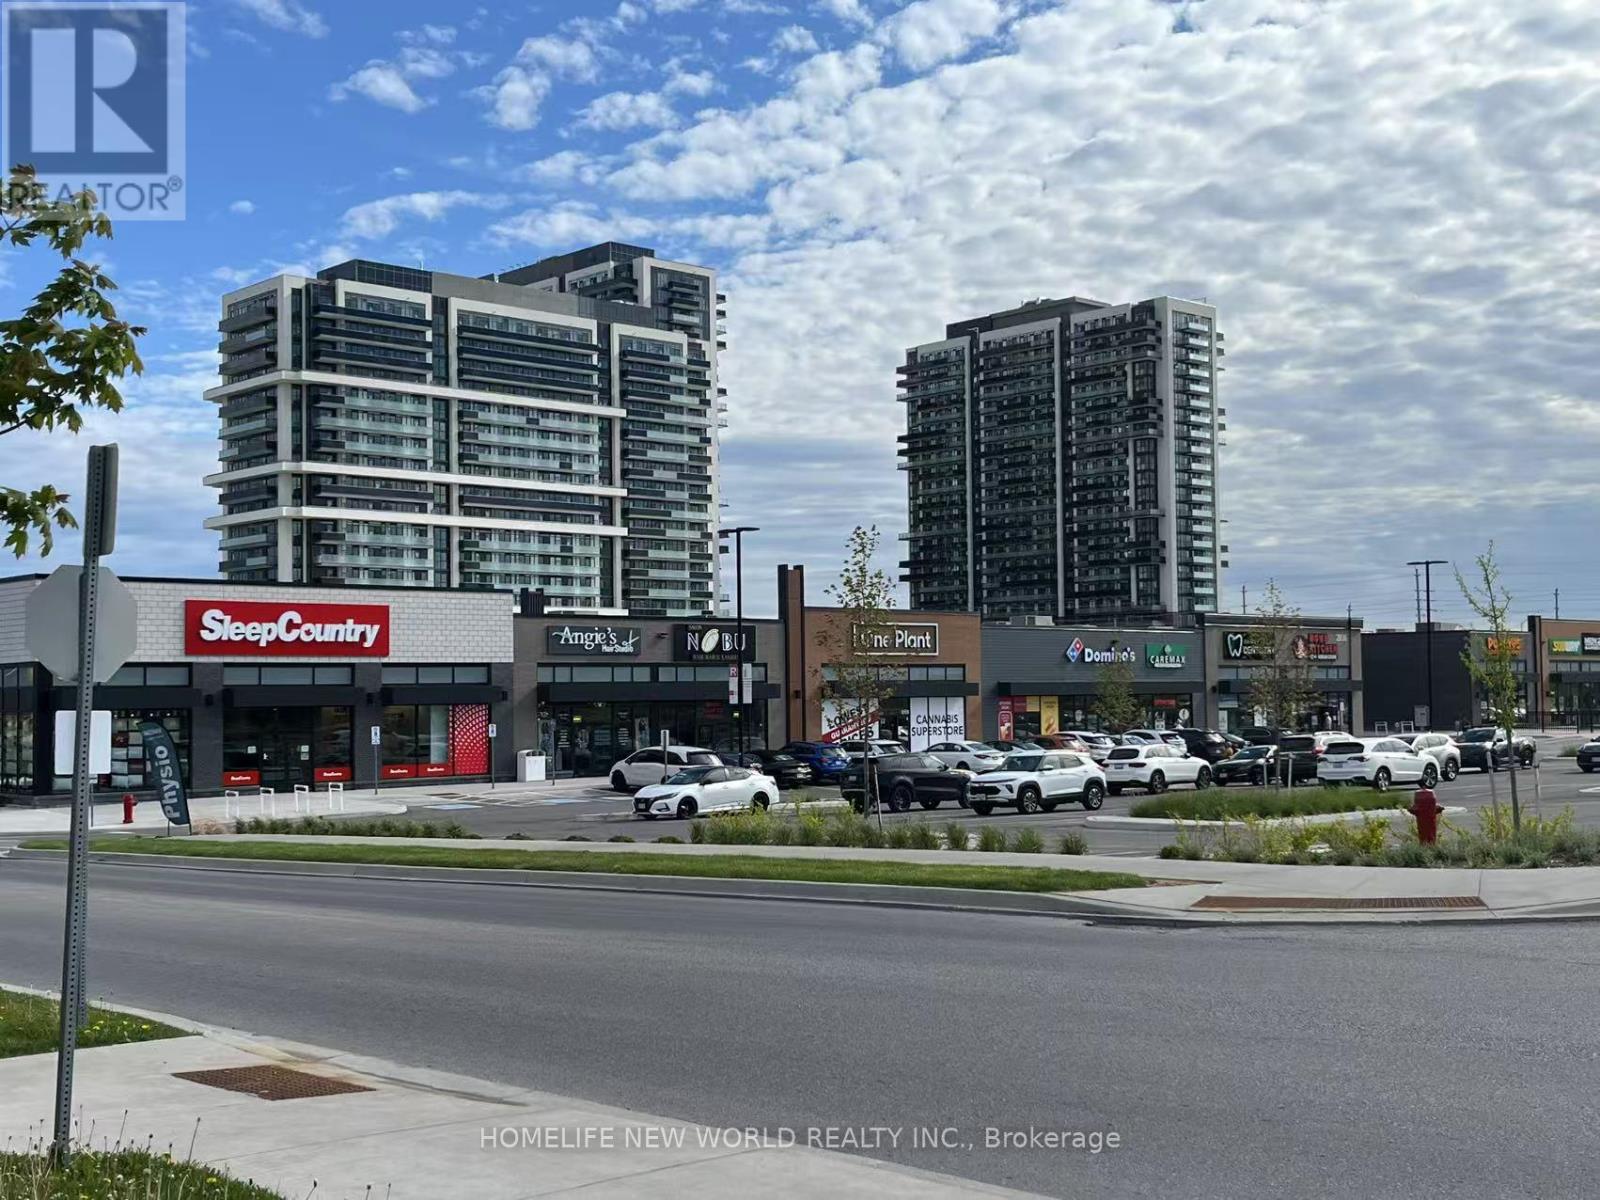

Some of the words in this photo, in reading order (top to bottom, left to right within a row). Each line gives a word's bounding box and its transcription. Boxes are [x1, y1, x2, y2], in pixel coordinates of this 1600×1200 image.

[552, 626, 617, 650] Angie's
[895, 629, 931, 648] Plant
[1084, 647, 1136, 663] Domino's
[1150, 655, 1186, 664] CAREMAX
[916, 714, 959, 725] CANNABIS
[911, 726, 964, 737] SUPERSTORE
[155, 745, 181, 818] Physio
